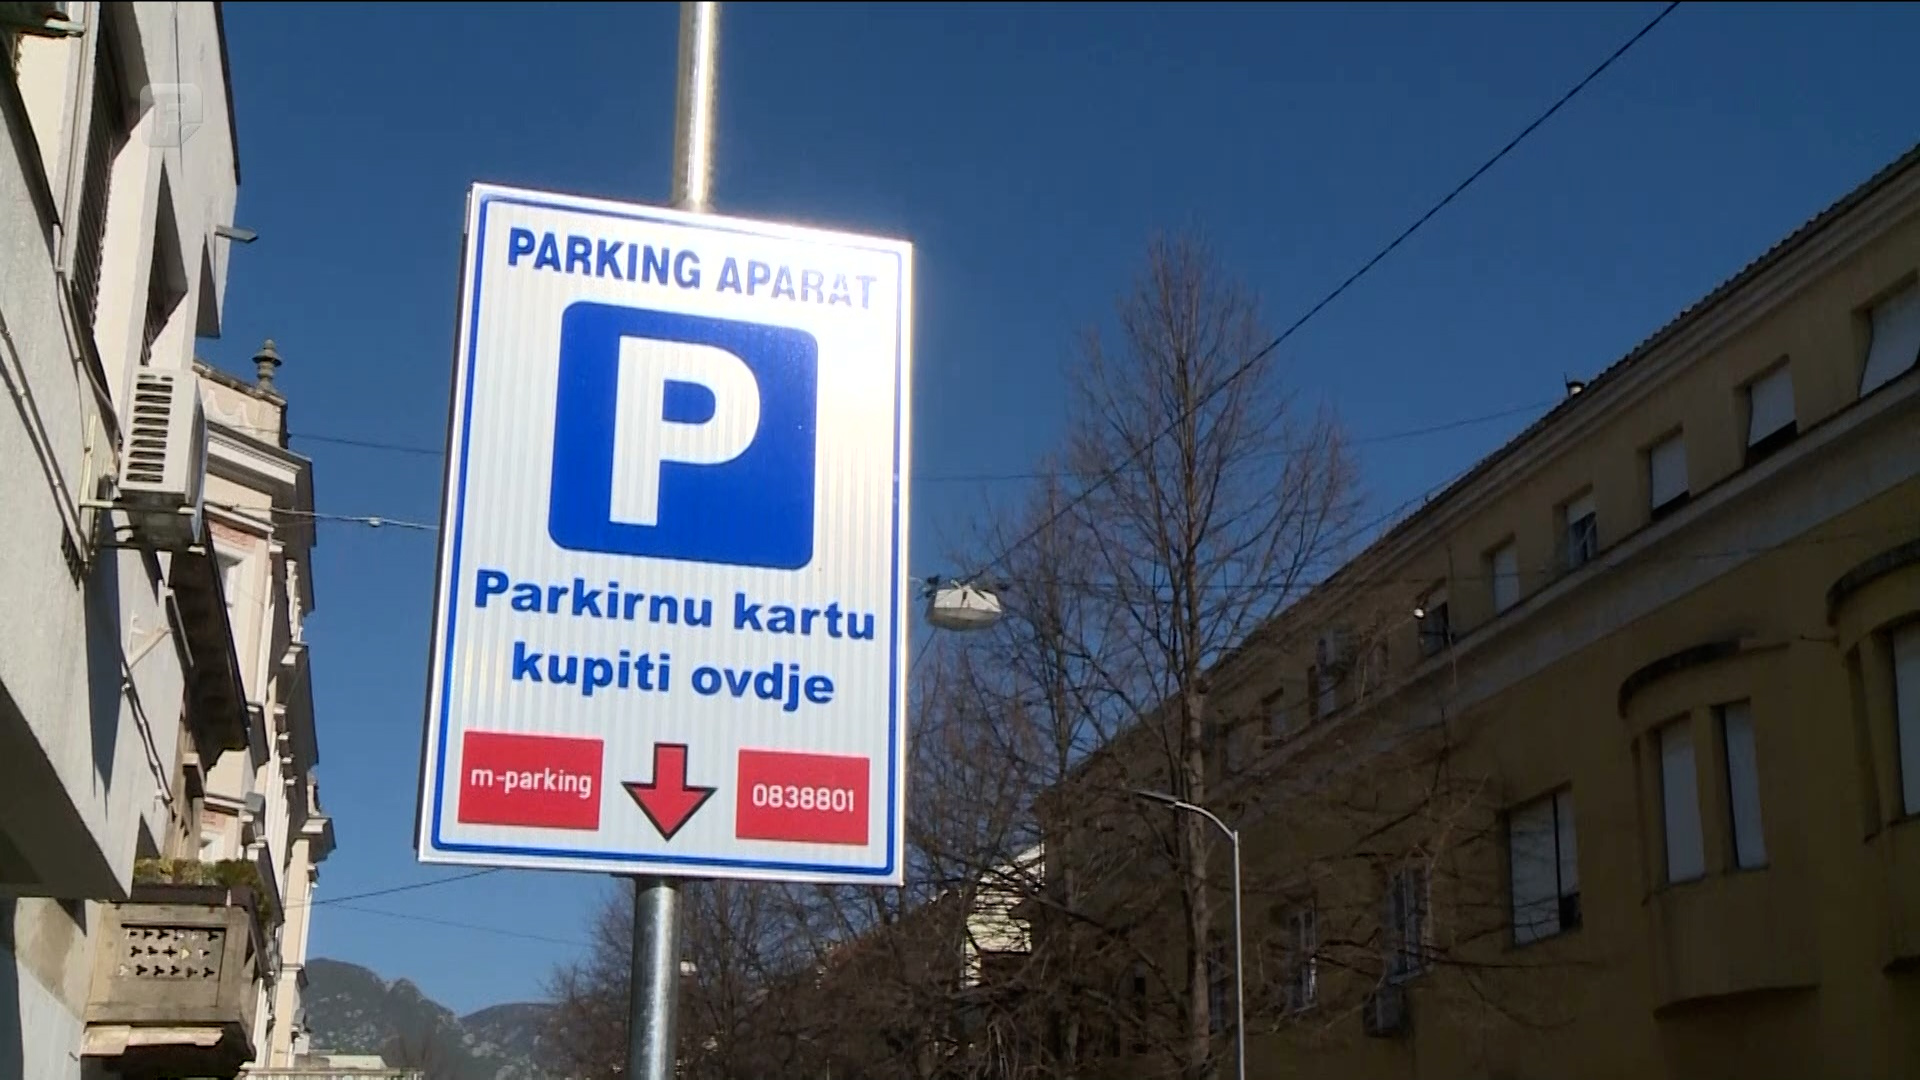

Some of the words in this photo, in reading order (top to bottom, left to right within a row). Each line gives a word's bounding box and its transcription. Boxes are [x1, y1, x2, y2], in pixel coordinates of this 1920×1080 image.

[508, 227, 701, 289] PARKING
[716, 256, 877, 310] APARAT
[609, 334, 760, 527] P
[474, 569, 712, 627] Parkirnu
[734, 592, 875, 640] kartu
[512, 641, 670, 696] kupiti
[691, 663, 835, 712] ovdje
[470, 766, 592, 799] m-parking
[752, 783, 855, 813] 0838801
